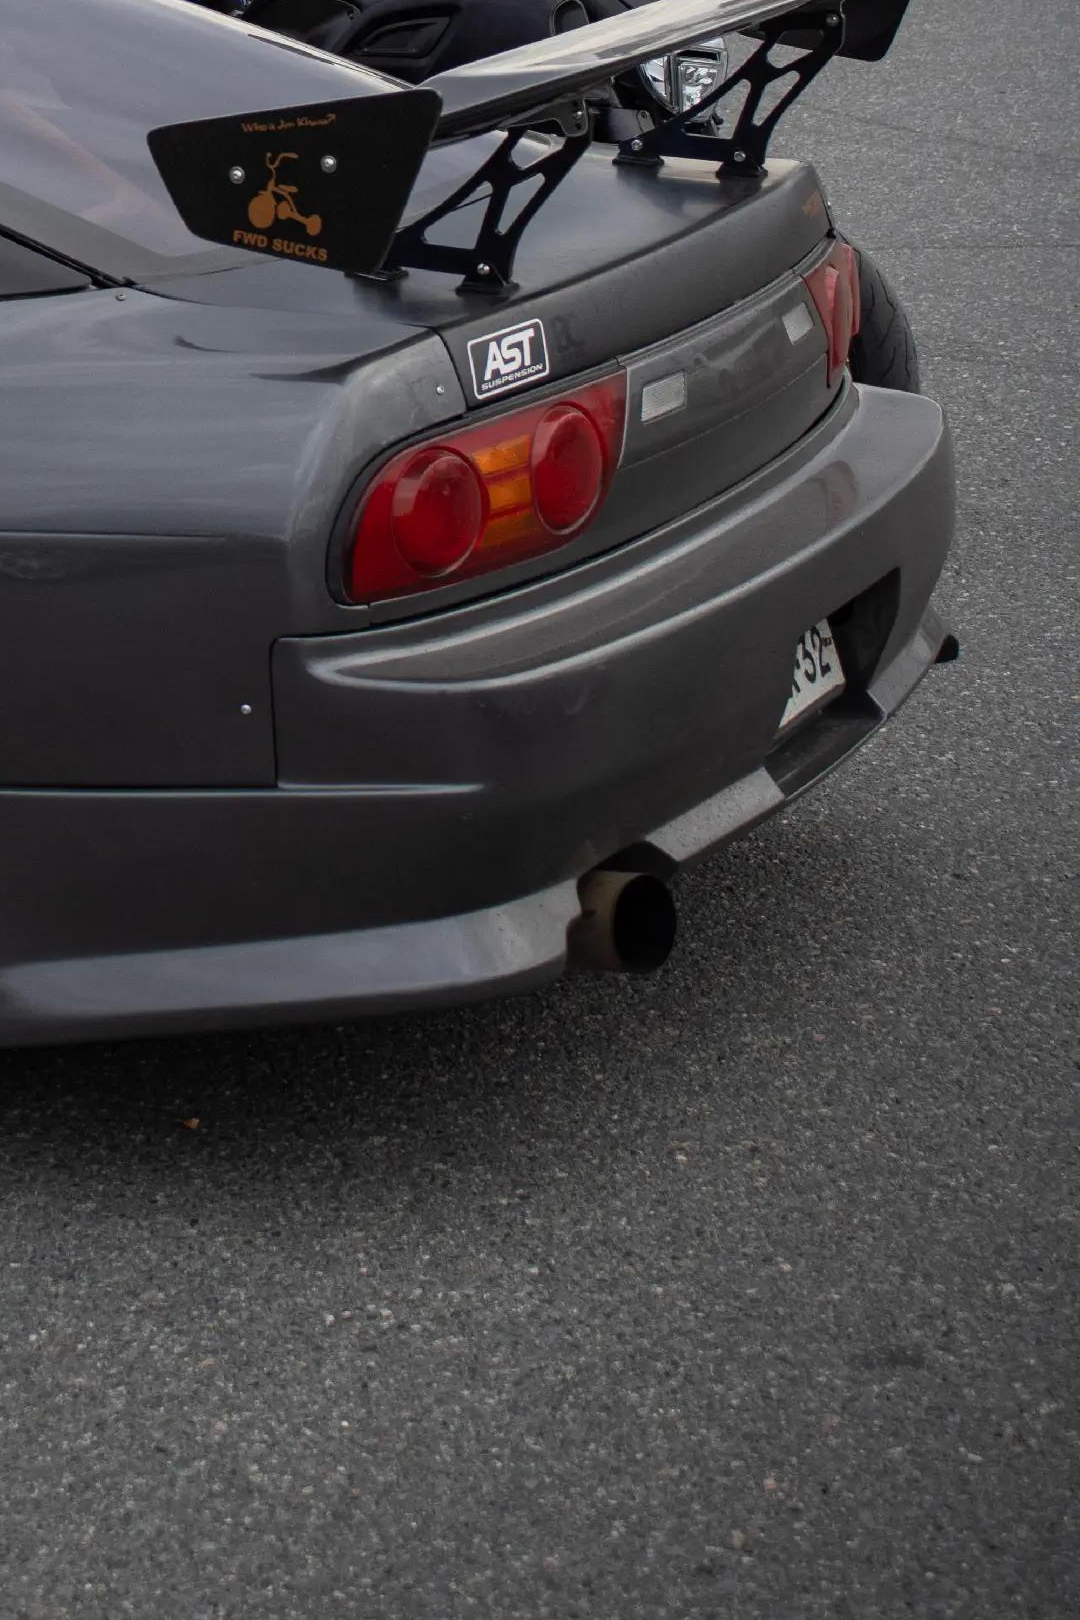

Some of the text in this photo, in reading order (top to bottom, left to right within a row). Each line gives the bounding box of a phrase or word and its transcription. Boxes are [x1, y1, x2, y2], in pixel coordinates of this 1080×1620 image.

[233, 229, 328, 262] FWD SUCKS
[484, 327, 535, 381] AST
[481, 363, 544, 391] SUSPENSION
